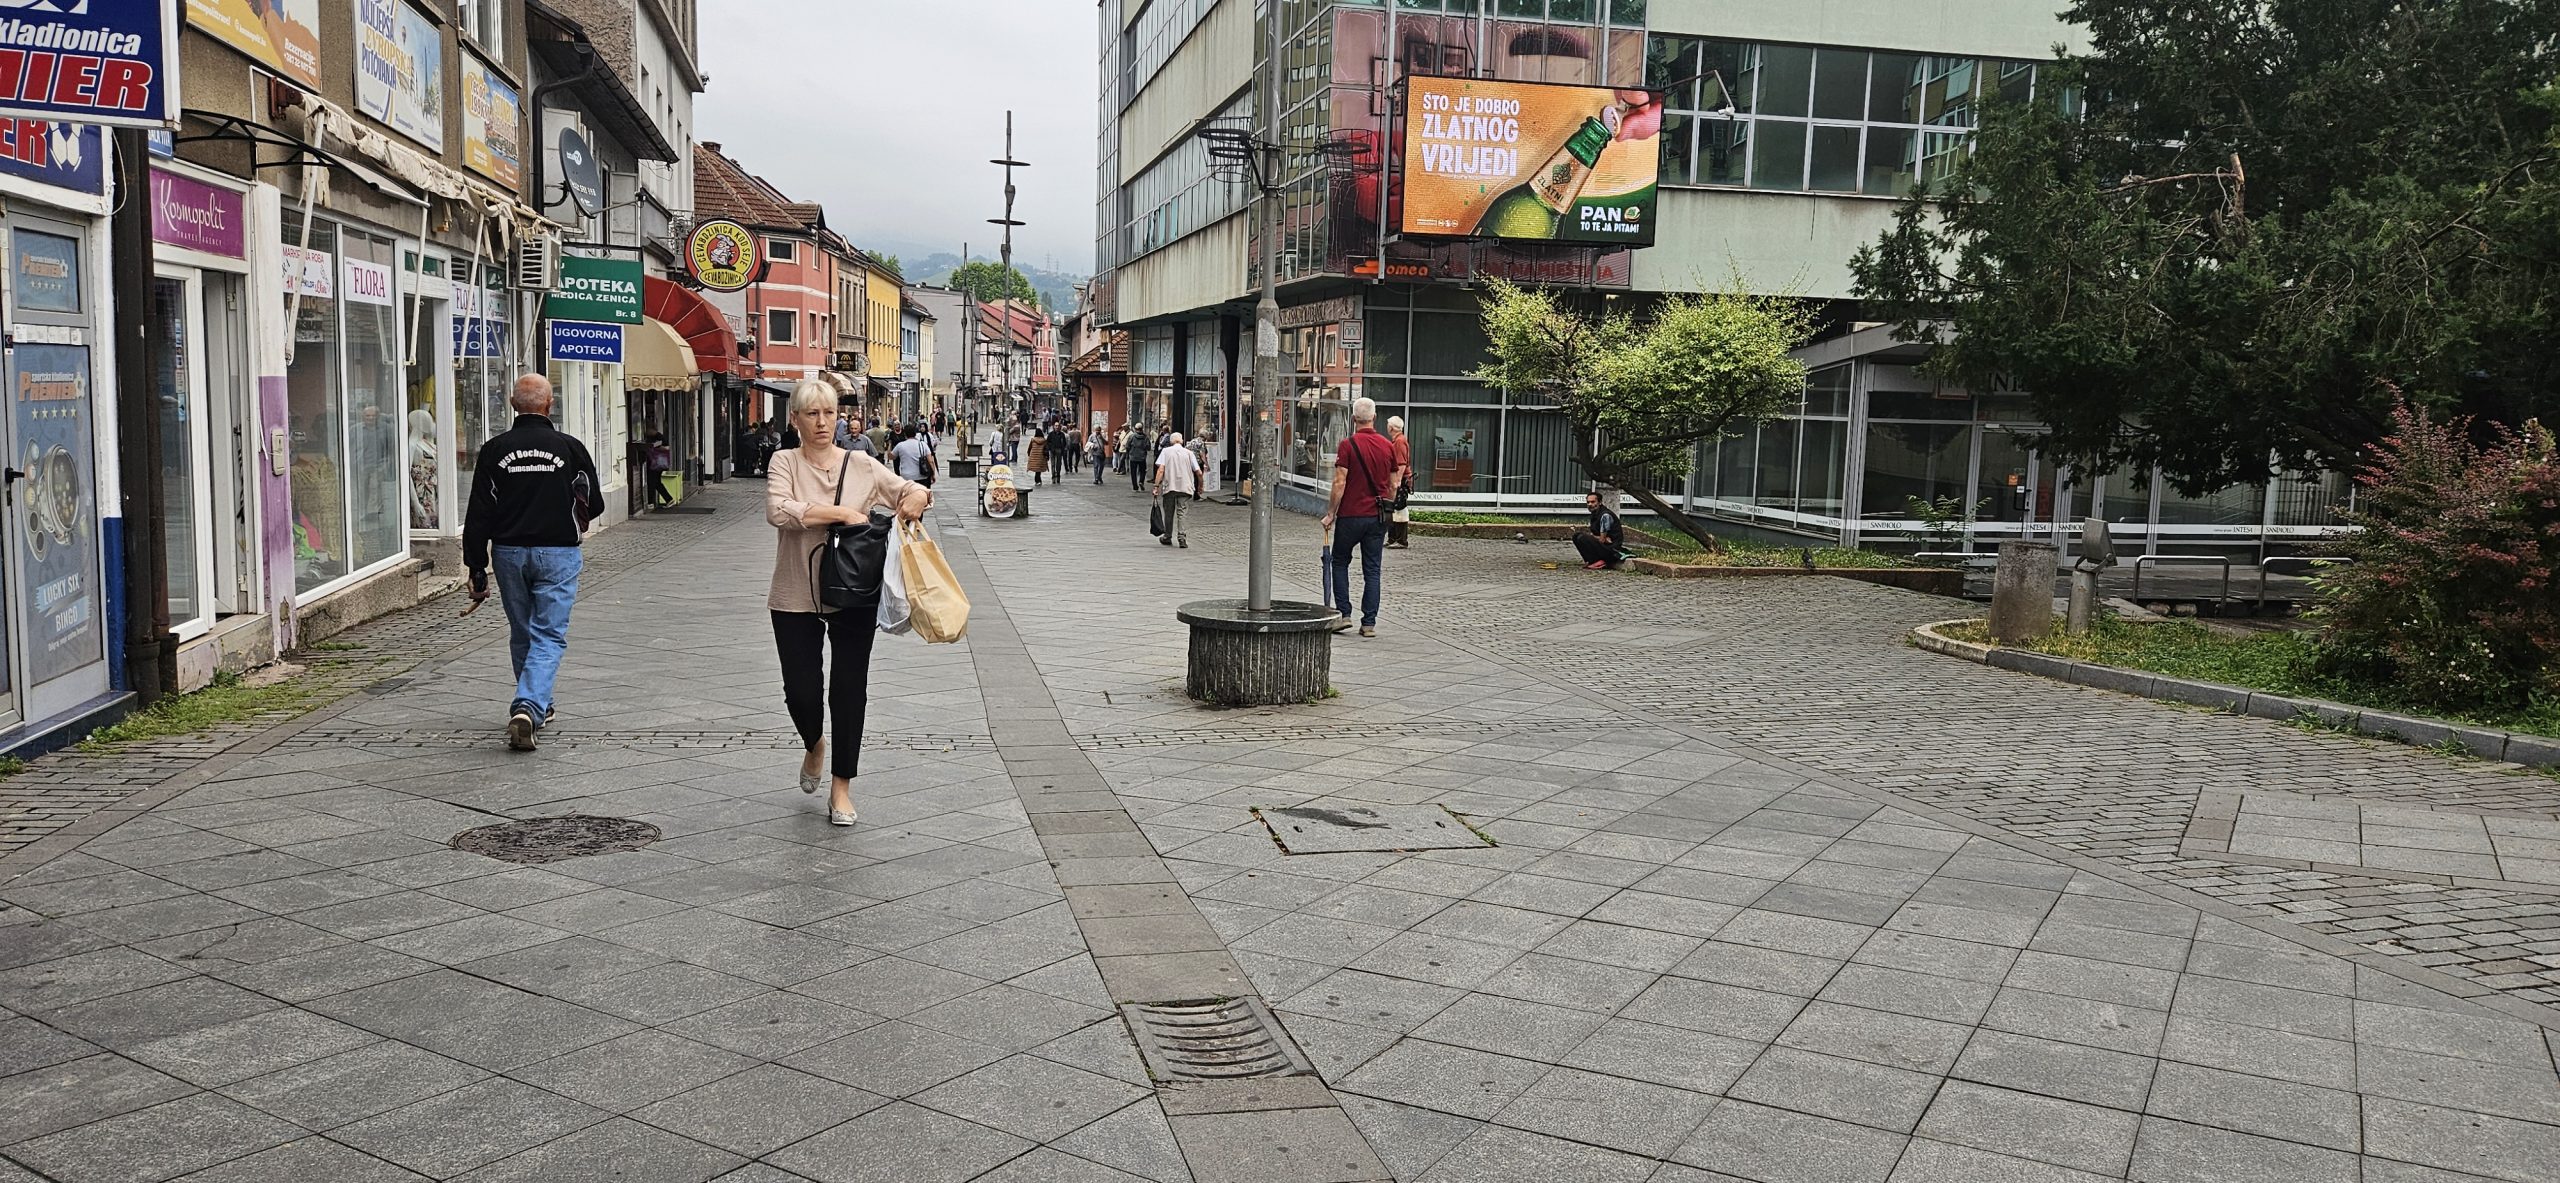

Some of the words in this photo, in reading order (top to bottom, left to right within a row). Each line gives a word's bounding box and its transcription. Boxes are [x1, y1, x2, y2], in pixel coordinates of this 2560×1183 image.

[1423, 92, 1449, 111] ŠTO
[1454, 96, 1471, 113] JE
[1474, 97, 1520, 116] DOBRO
[1422, 113, 1519, 143] ZLATNOG
[1421, 143, 1518, 177] VRIJEDI
[1537, 175, 1564, 202] ZLATNI
[160, 178, 226, 244] Kosmopolit
[1580, 206, 1622, 222] PAN
[1580, 221, 1591, 231] TO
[1592, 222, 1601, 232] TE
[1602, 223, 1612, 232] JA
[177, 230, 198, 242] TRAVEL
[202, 235, 222, 246] AGENCY
[734, 231, 747, 247] KOD
[353, 267, 386, 298] FLORA
[551, 291, 594, 301] MEDICA
[595, 293, 637, 305] ZENICA
[615, 309, 628, 318] Br.
[630, 310, 637, 318] 8
[554, 327, 620, 340] UGOVORNA
[559, 344, 614, 356] APOTEKA
[498, 451, 517, 469] WSV
[516, 448, 554, 461] Bochum
[43, 578, 66, 605] LUCKY
[67, 572, 80, 594] SIX
[55, 605, 78, 632] BINGO
